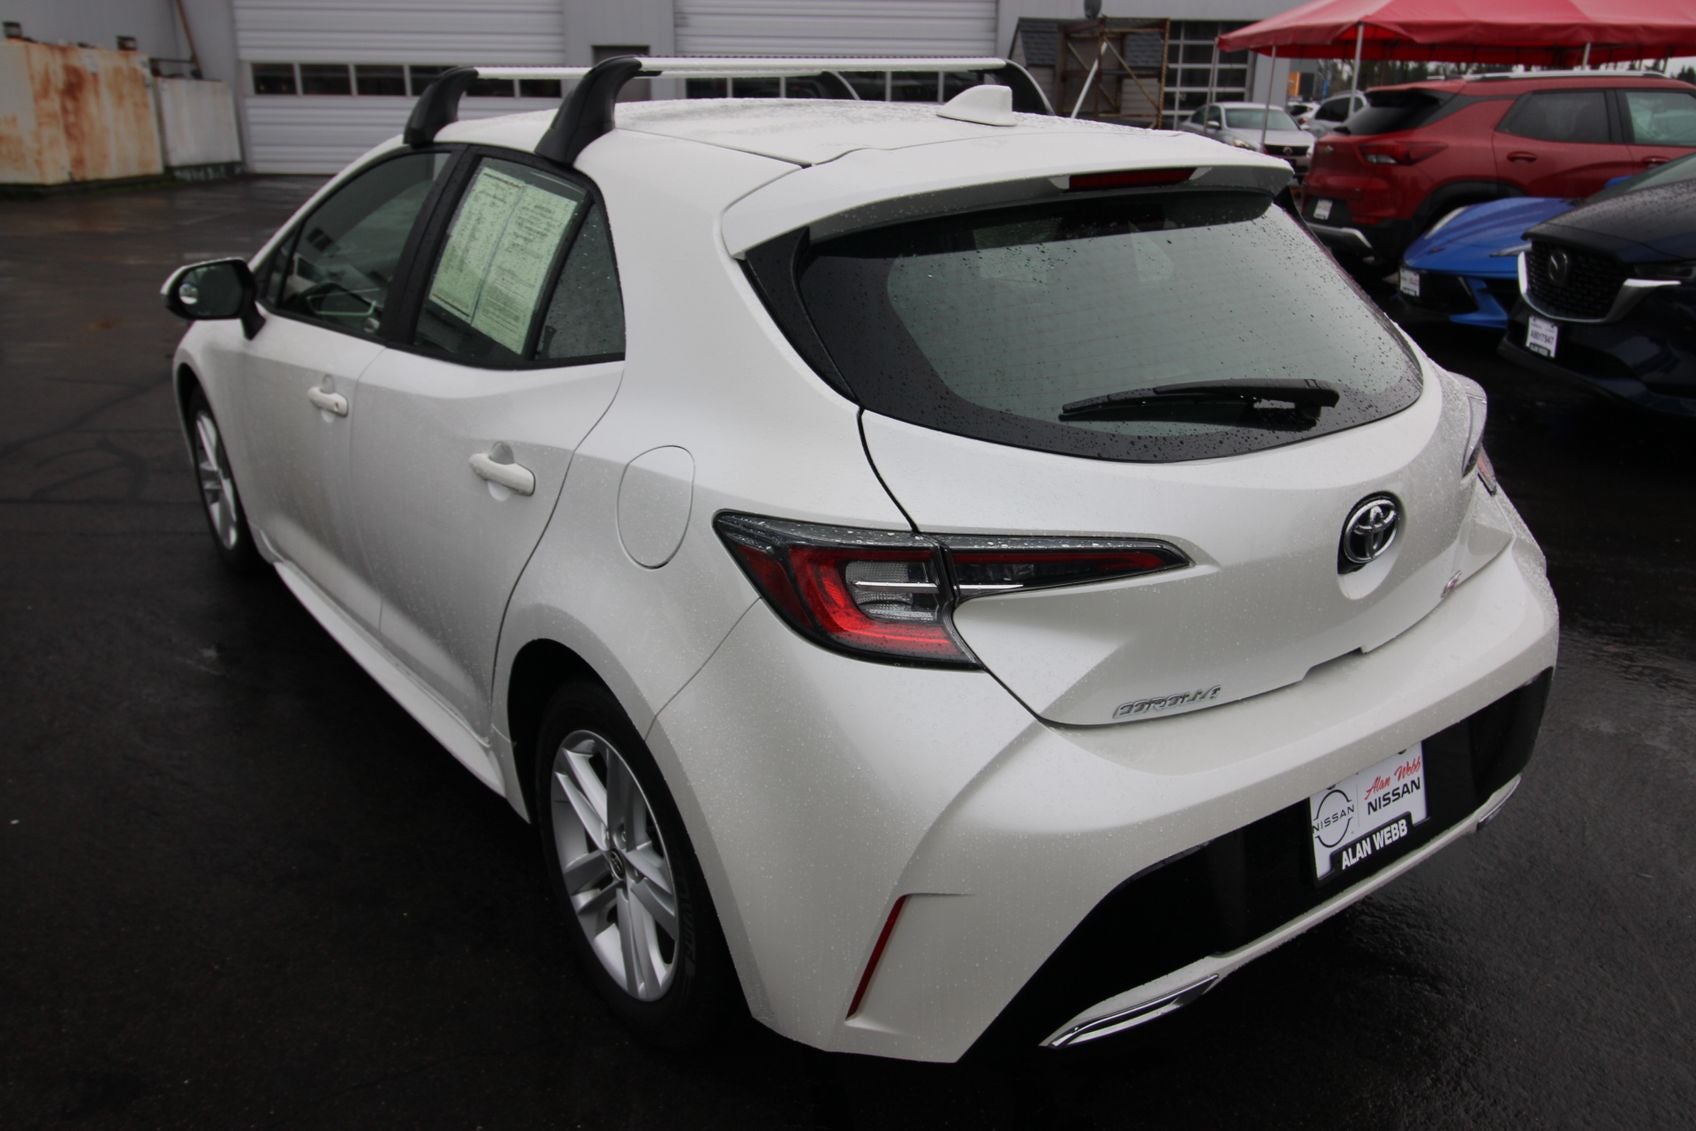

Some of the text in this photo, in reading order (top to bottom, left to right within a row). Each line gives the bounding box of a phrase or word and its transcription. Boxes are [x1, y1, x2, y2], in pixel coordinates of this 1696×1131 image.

[1364, 775, 1391, 801] Alan
[1367, 777, 1421, 815] NISSAN
[1312, 804, 1355, 835] NISSAN
[1341, 819, 1408, 871] ALAN WEBB
